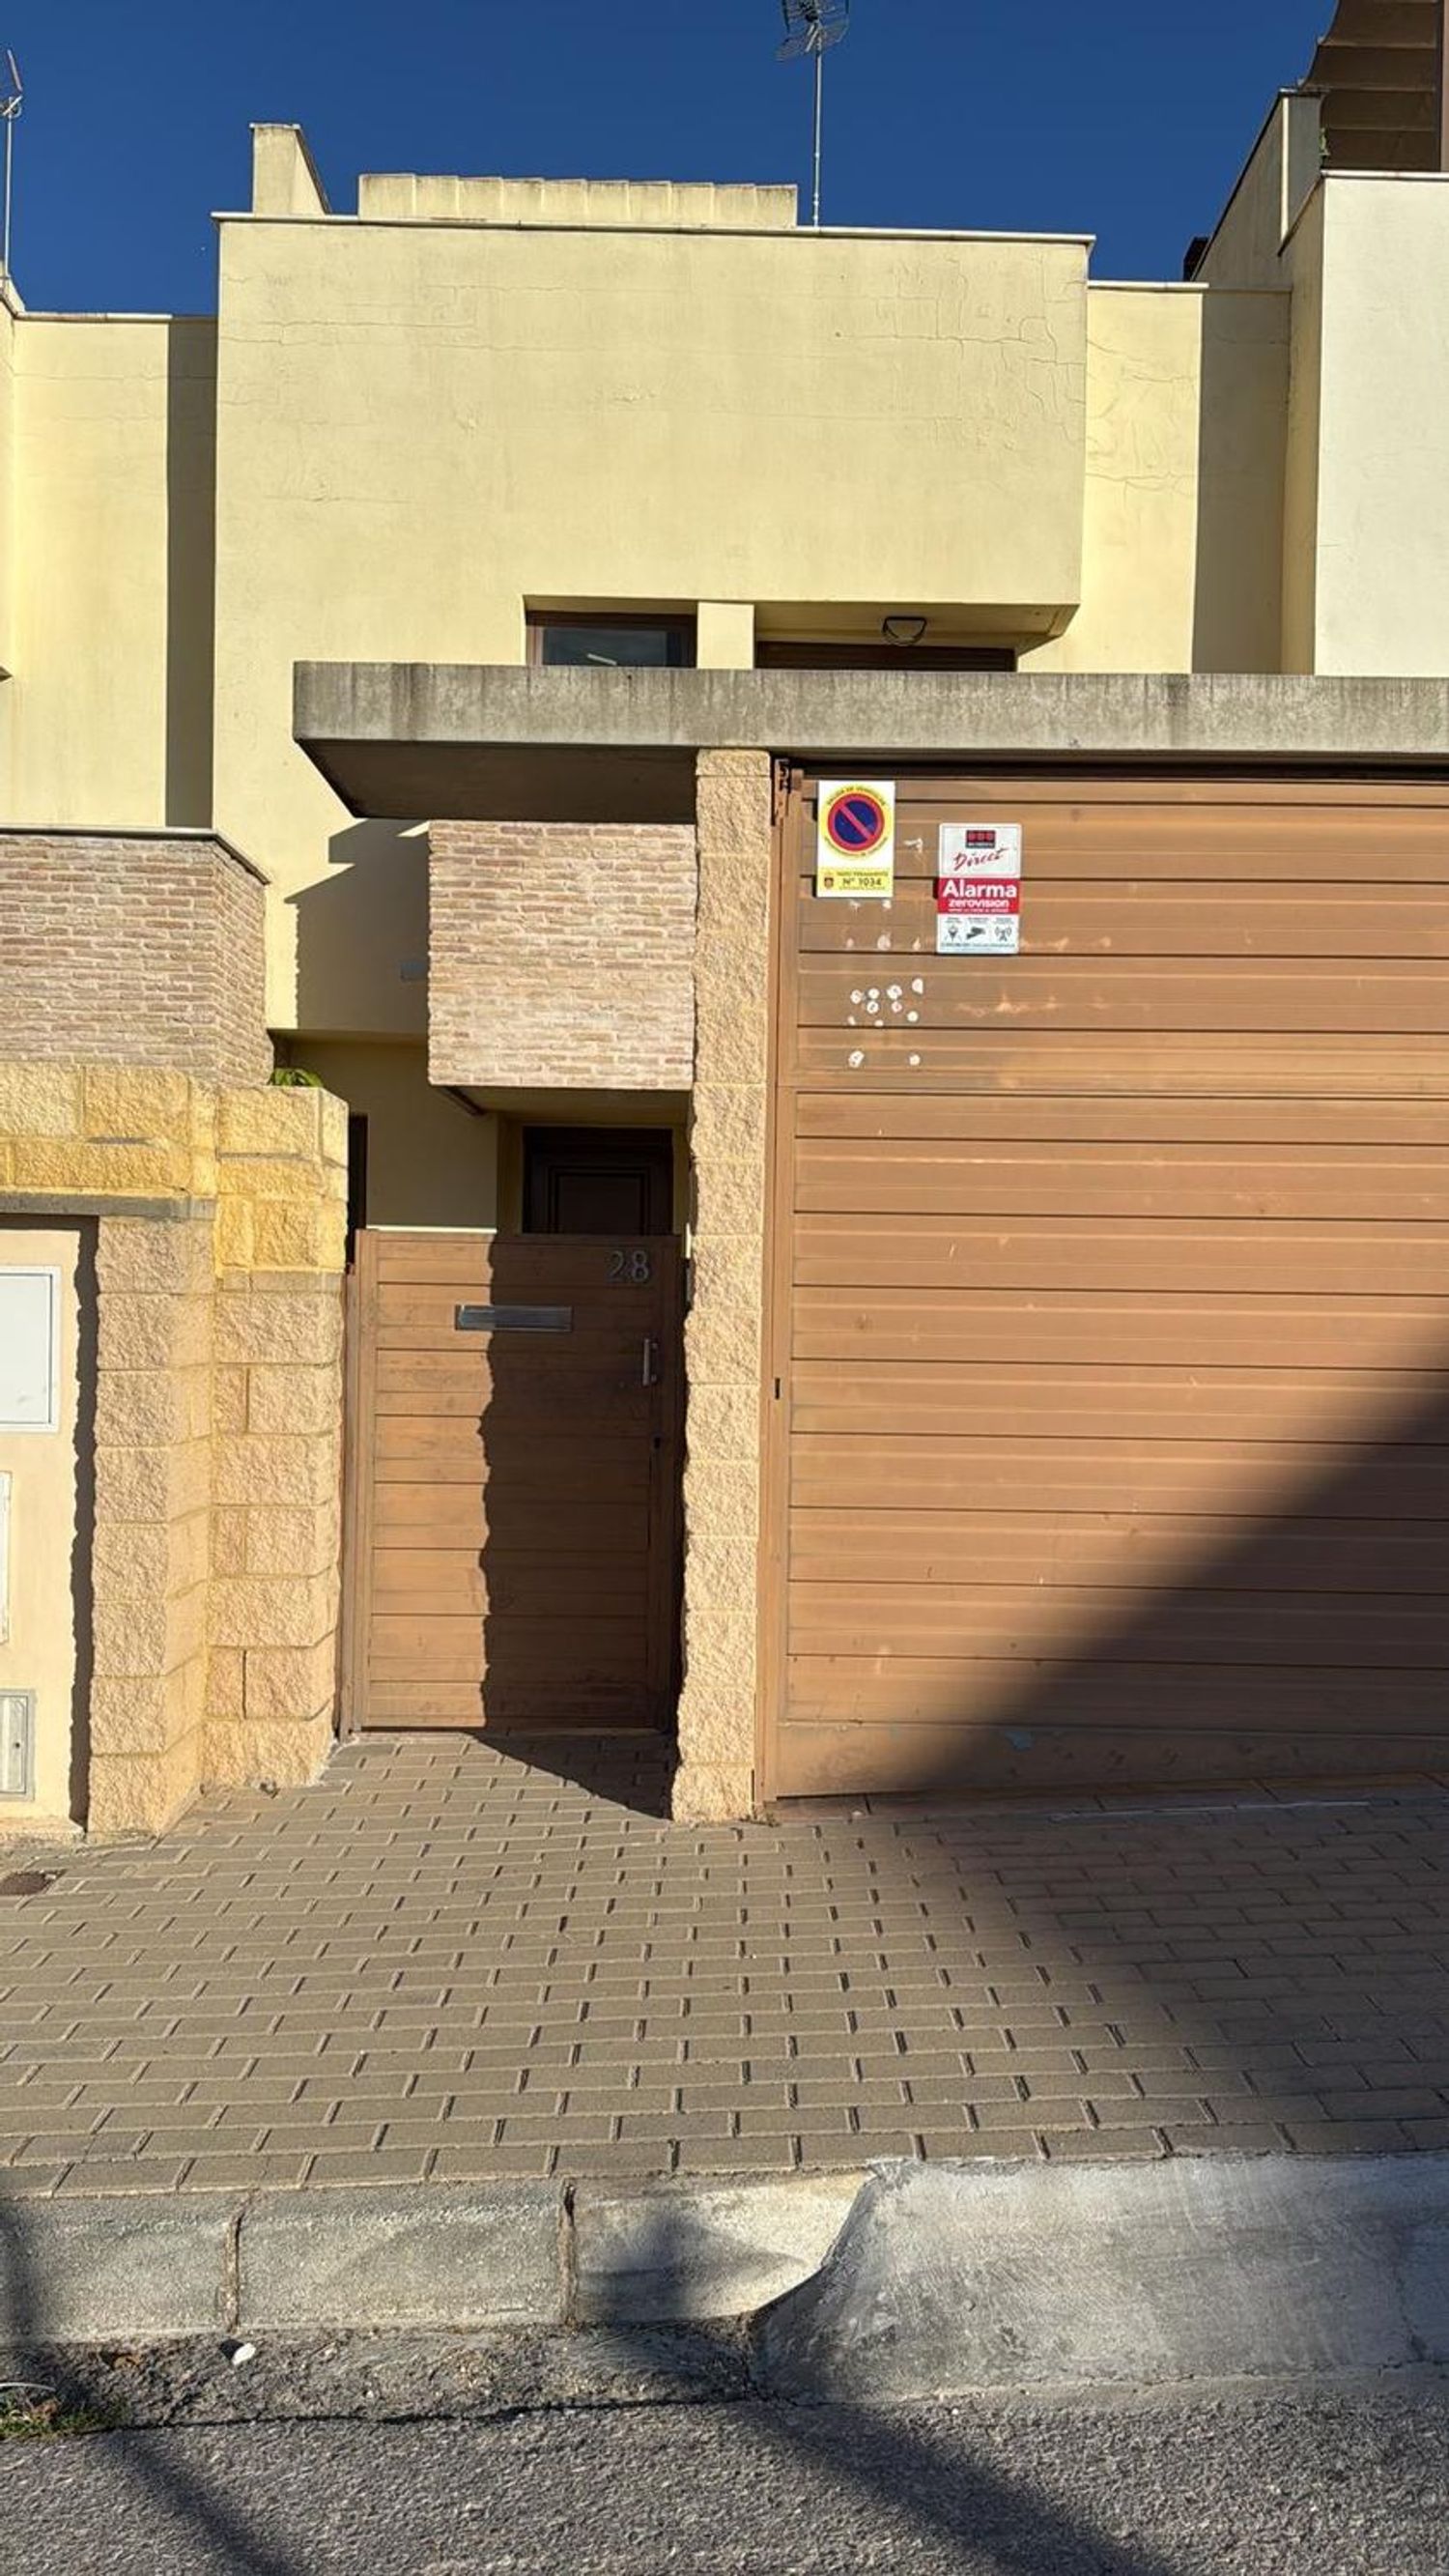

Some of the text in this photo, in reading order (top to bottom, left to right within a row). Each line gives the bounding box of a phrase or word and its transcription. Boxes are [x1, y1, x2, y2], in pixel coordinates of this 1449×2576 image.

[952, 846, 1009, 872] Direct
[858, 877, 882, 887] 1034
[942, 878, 1017, 898] Alarma
[948, 899, 1009, 908] zerovision
[606, 1249, 649, 1283] 28
